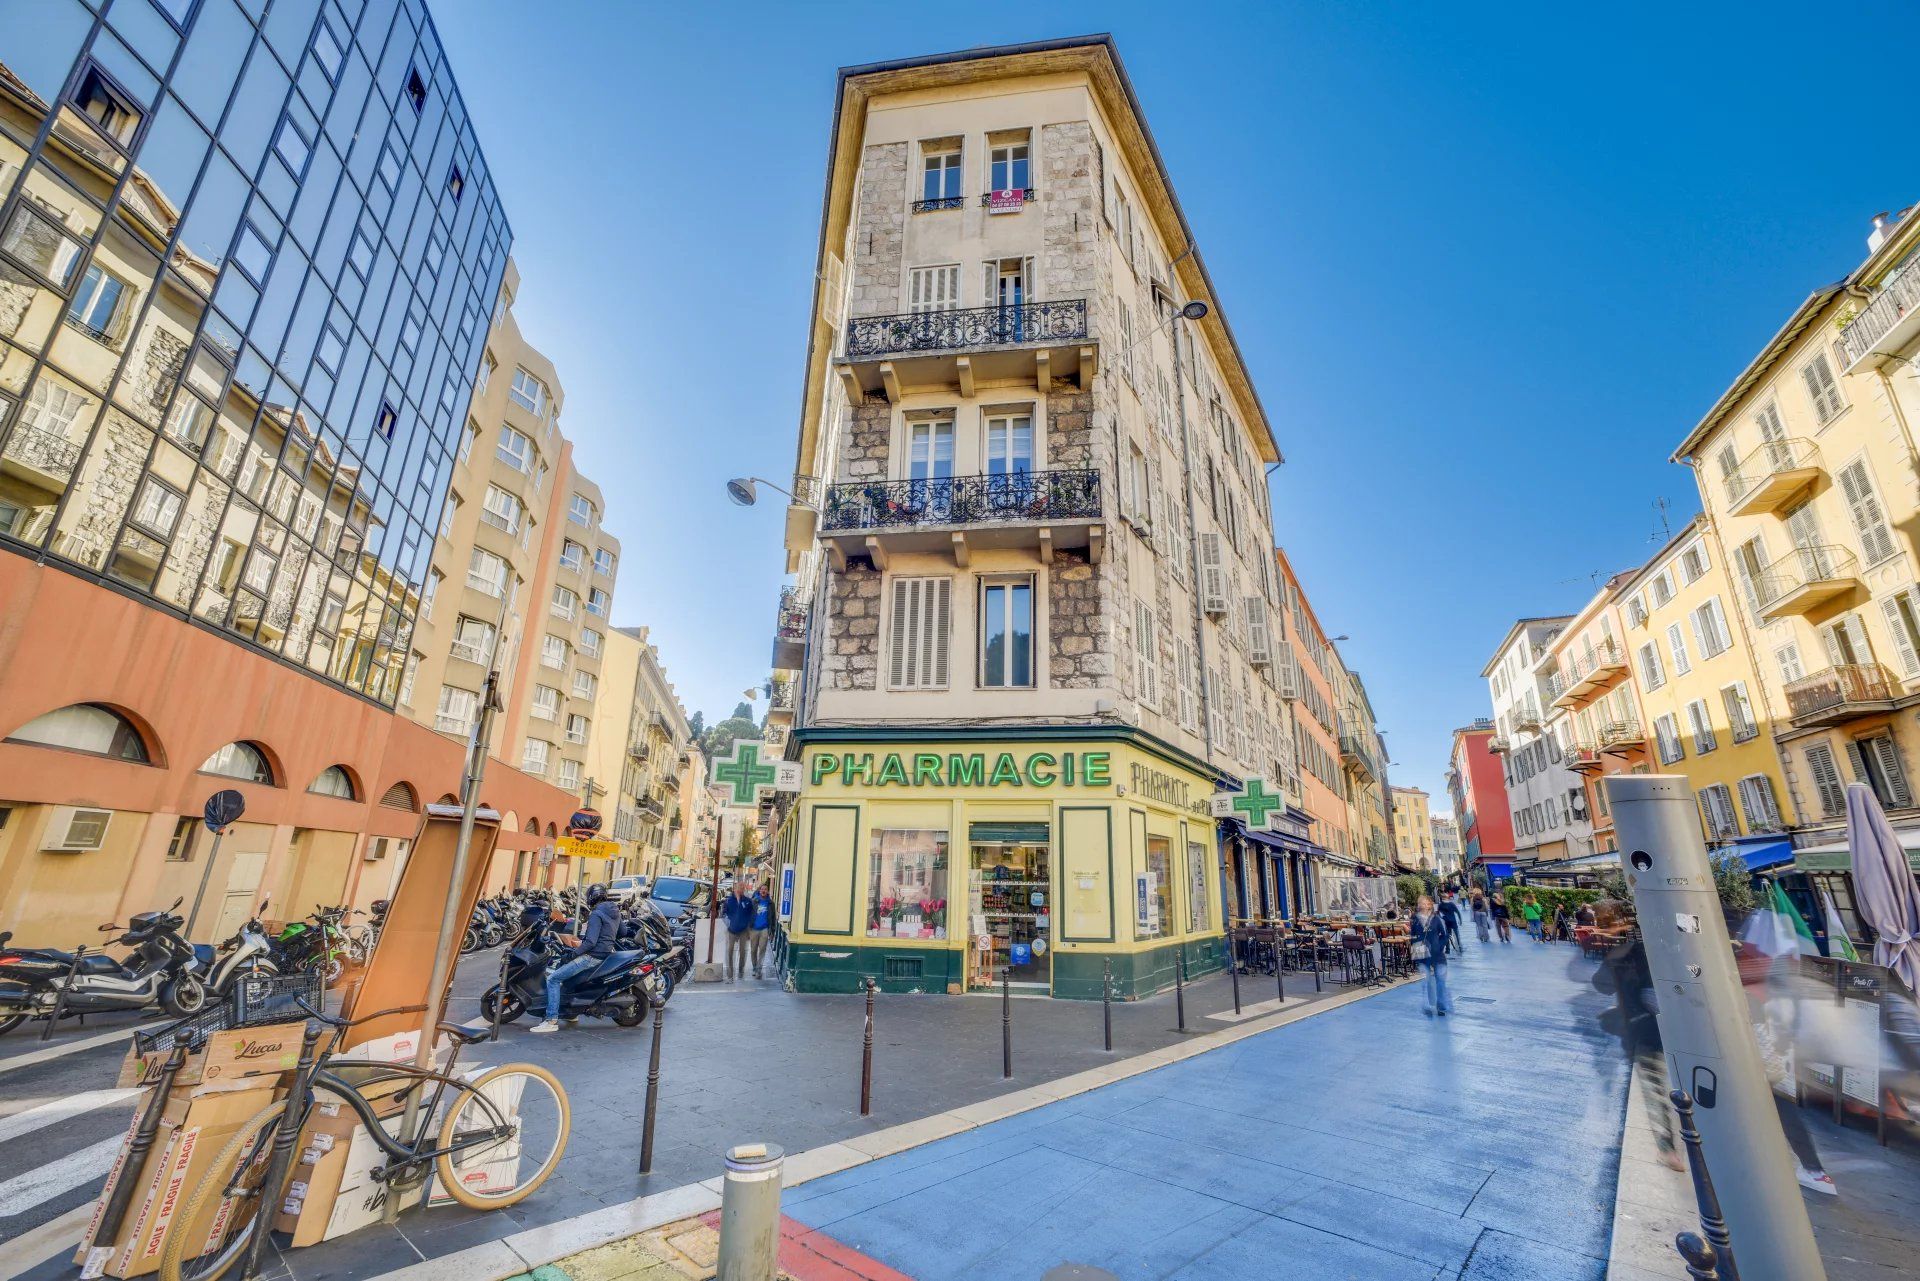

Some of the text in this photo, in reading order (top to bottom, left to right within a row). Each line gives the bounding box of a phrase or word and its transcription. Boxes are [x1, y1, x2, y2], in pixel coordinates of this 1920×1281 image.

[811, 752, 1111, 787] PHARMACIE
[1131, 762, 1190, 810] PHARMACIE
[234, 1040, 283, 1060] Lucas
[178, 1132, 197, 1170] FRAGILE
[105, 1154, 124, 1193] FRAGILE
[152, 1151, 170, 1191] FRAGILE
[160, 1177, 182, 1218] FRAGILE
[84, 1201, 105, 1240] FRAGILE
[132, 1199, 152, 1240] FRAGILE
[210, 1199, 232, 1240] FRAGILE
